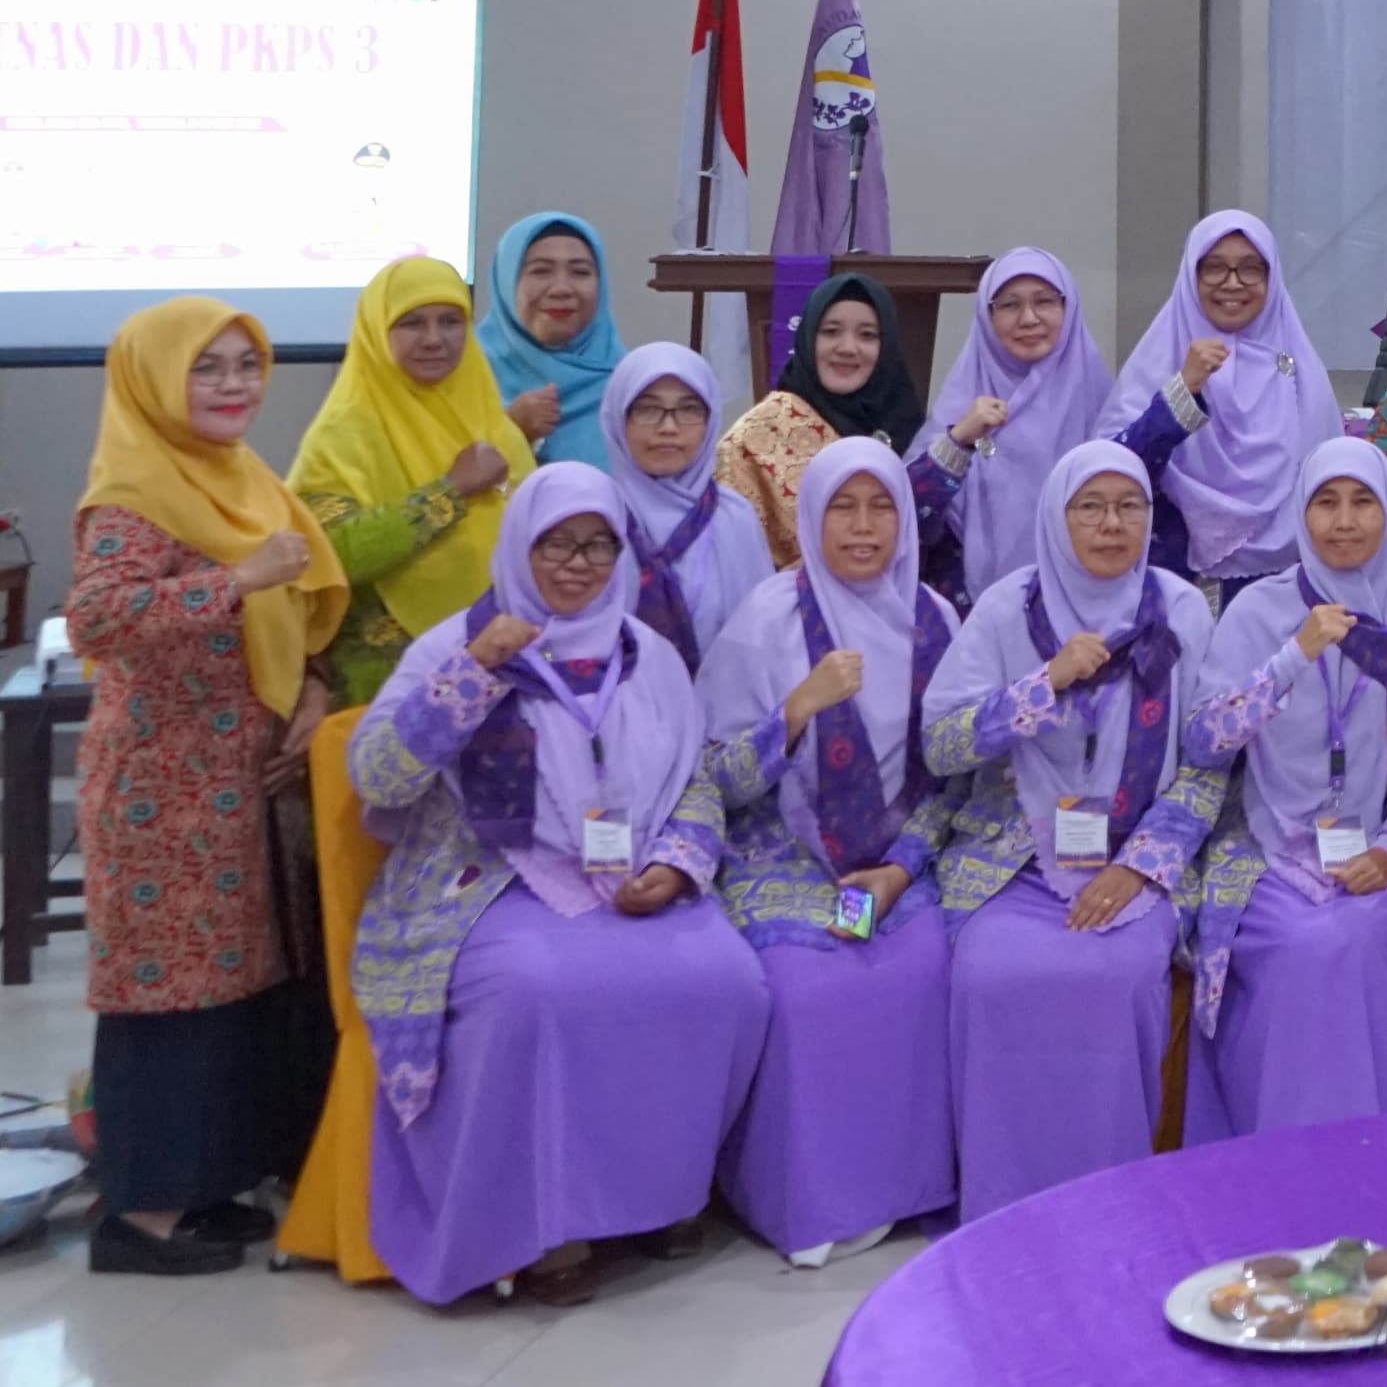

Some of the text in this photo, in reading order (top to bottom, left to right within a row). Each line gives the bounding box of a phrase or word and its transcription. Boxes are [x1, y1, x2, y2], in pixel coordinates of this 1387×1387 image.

[111, 21, 200, 70] DAN
[217, 22, 337, 73] PKPS
[354, 24, 380, 74] 3
